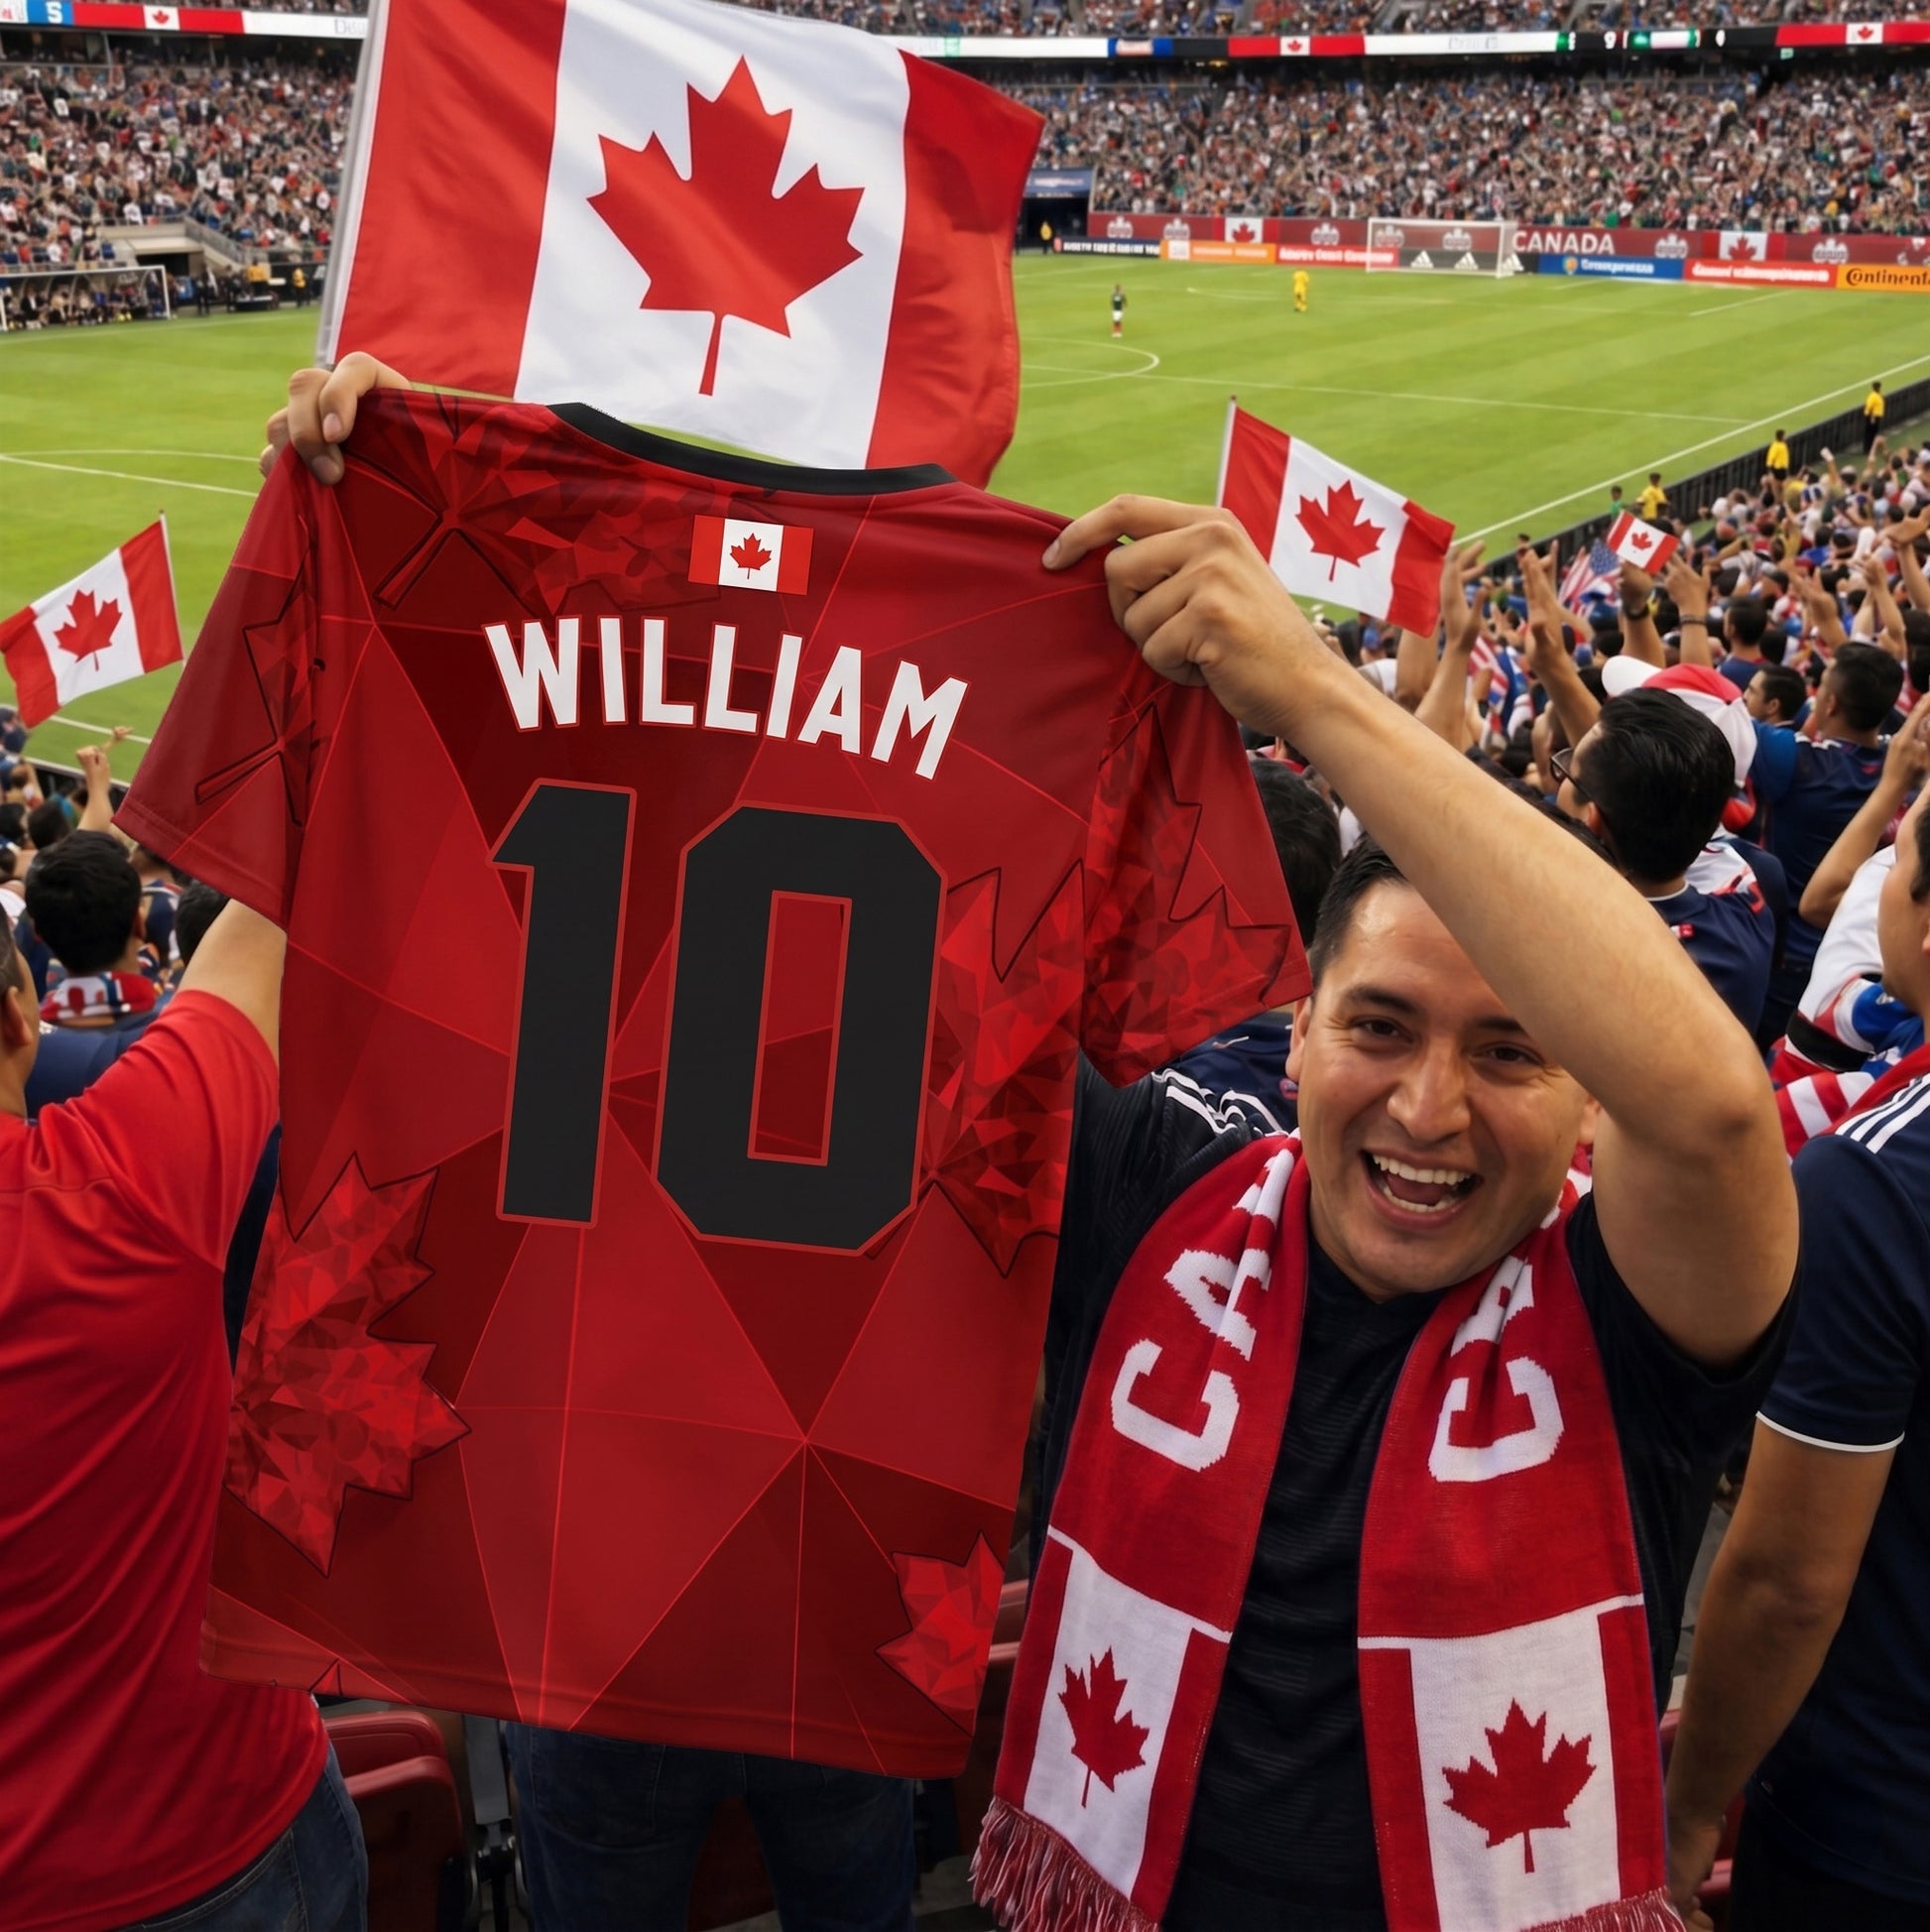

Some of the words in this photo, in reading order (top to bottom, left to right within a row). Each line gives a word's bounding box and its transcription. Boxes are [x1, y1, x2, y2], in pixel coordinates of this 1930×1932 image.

[1511, 229, 1615, 255] CANADA
[1846, 267, 1930, 287] Continent
[484, 617, 969, 781] WILLIAM
[484, 777, 949, 1258] 10
